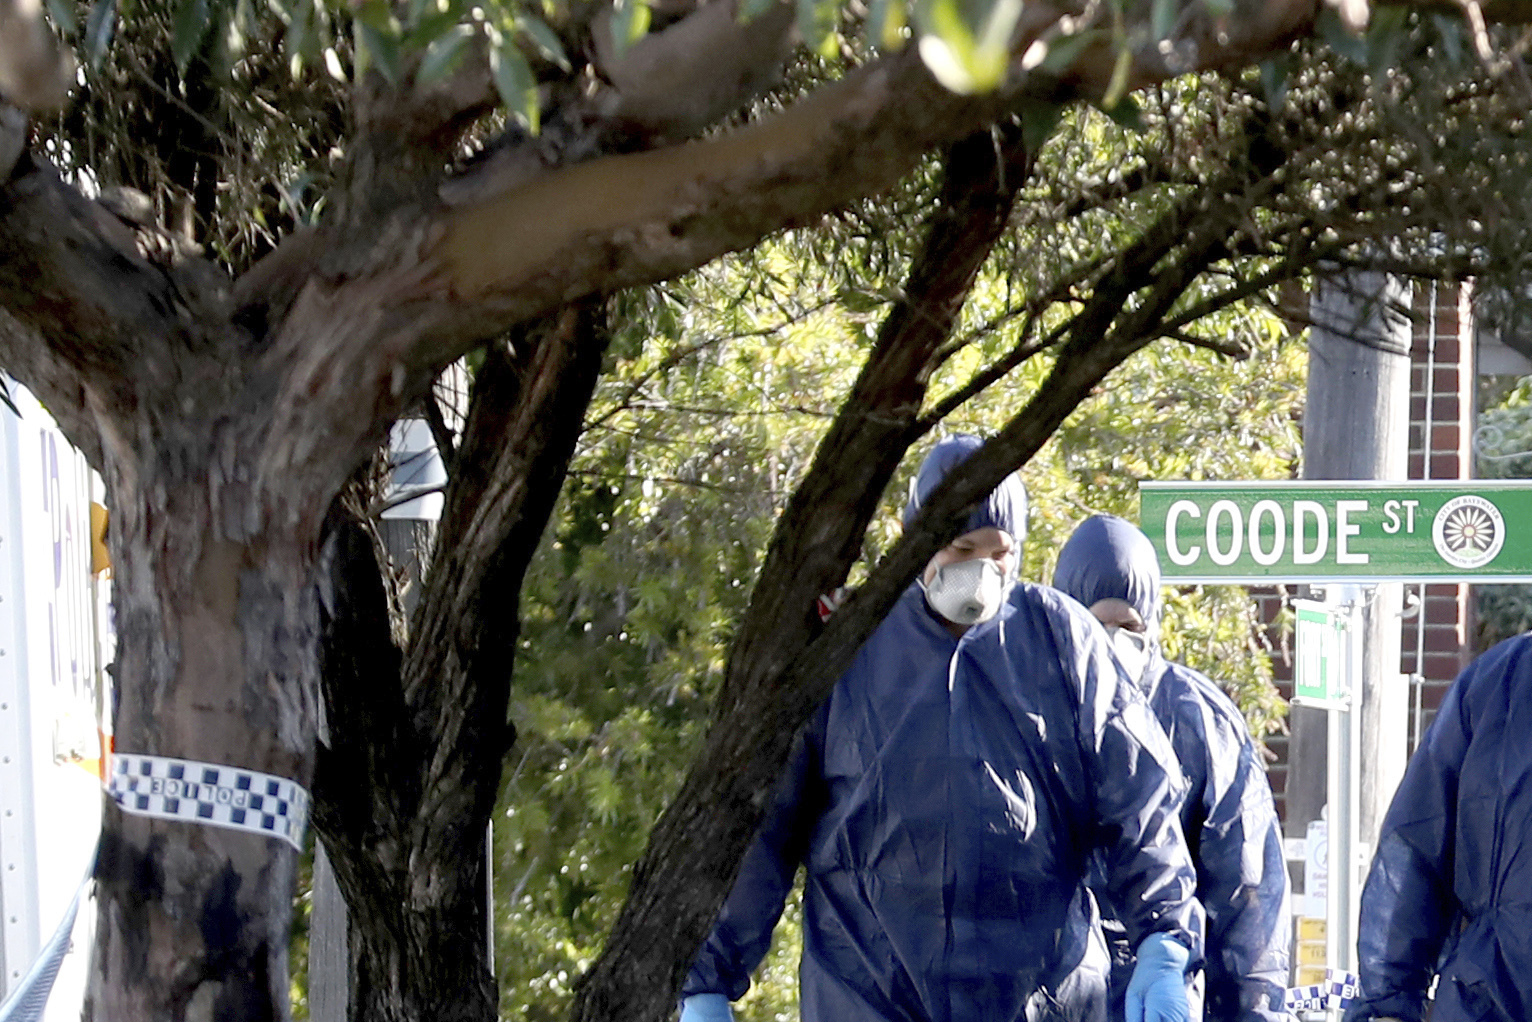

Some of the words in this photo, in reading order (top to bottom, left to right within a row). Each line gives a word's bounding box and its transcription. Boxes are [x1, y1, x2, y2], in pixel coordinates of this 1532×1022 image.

[1438, 505, 1452, 521] CITY
[1462, 498, 1500, 520] BAYSWATER
[1164, 499, 1371, 566] COODE
[1382, 499, 1420, 534] ST
[151, 777, 248, 806] POLICE
